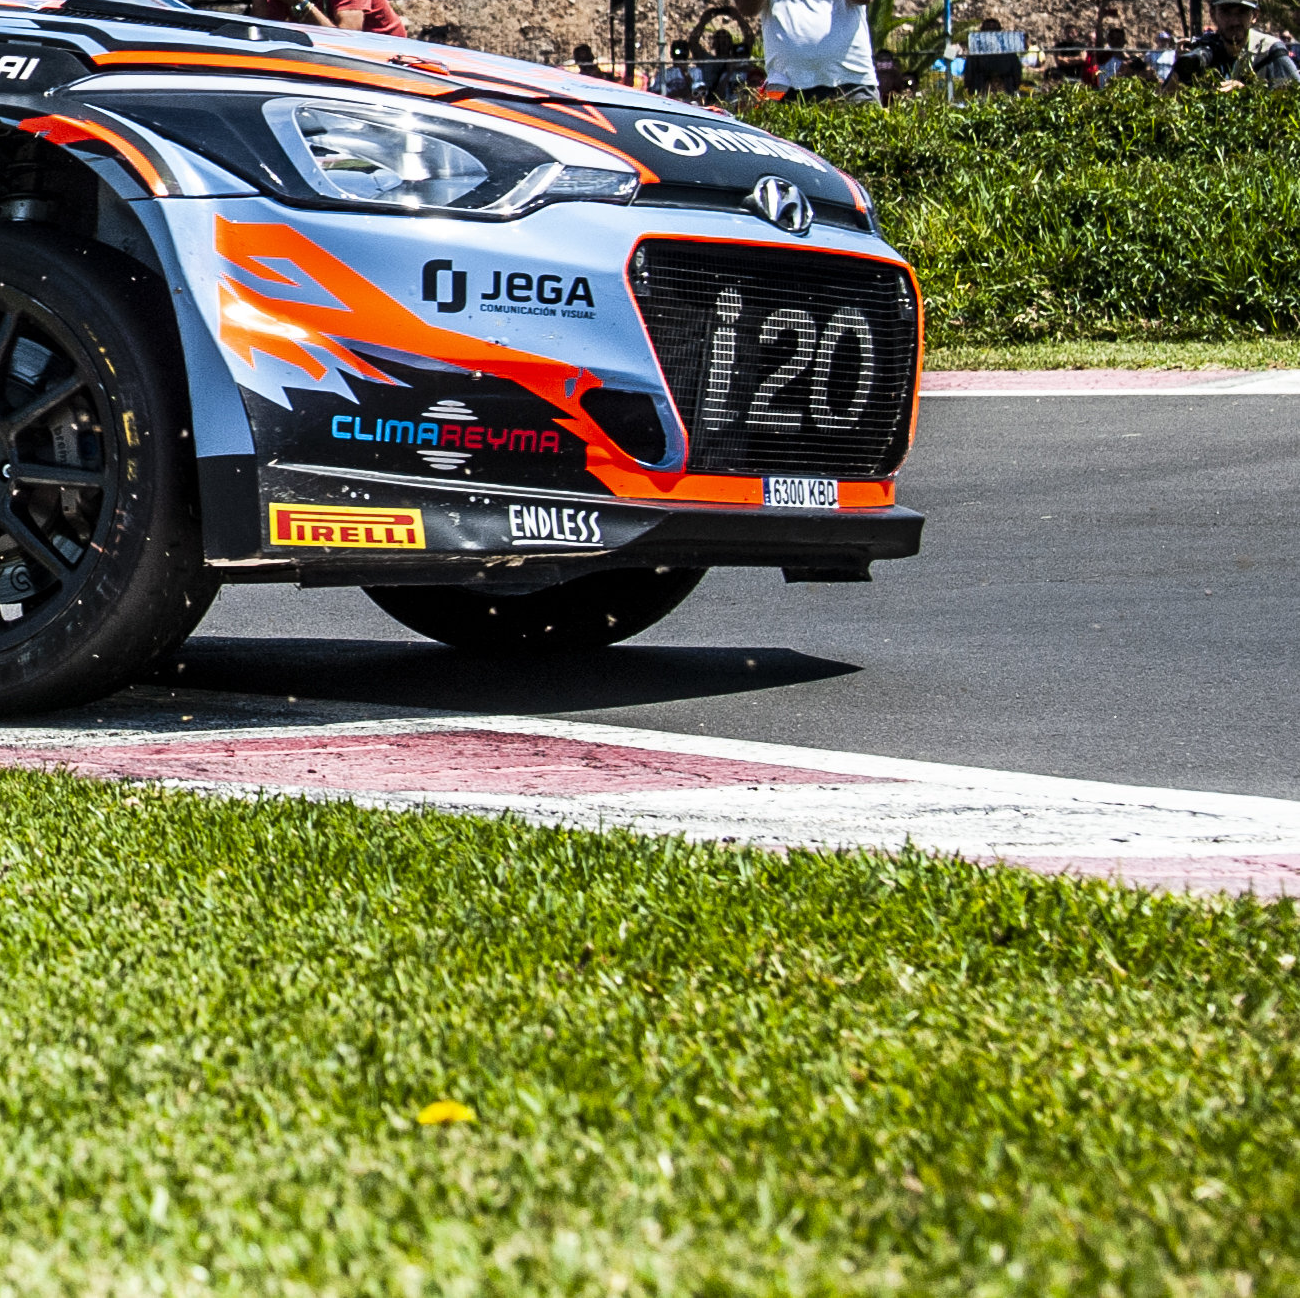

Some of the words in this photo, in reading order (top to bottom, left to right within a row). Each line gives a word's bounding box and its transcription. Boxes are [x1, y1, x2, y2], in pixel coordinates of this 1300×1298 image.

[480, 303, 556, 317] COMUNICACIÓN
[561, 309, 597, 320] VISUAL
[702, 287, 873, 433] i20
[331, 415, 560, 453] CLIMAREYMA
[773, 479, 805, 505] 6300
[808, 480, 837, 506] KBD
[276, 509, 415, 545] PIRELLI
[509, 505, 601, 543] ENDLESS
